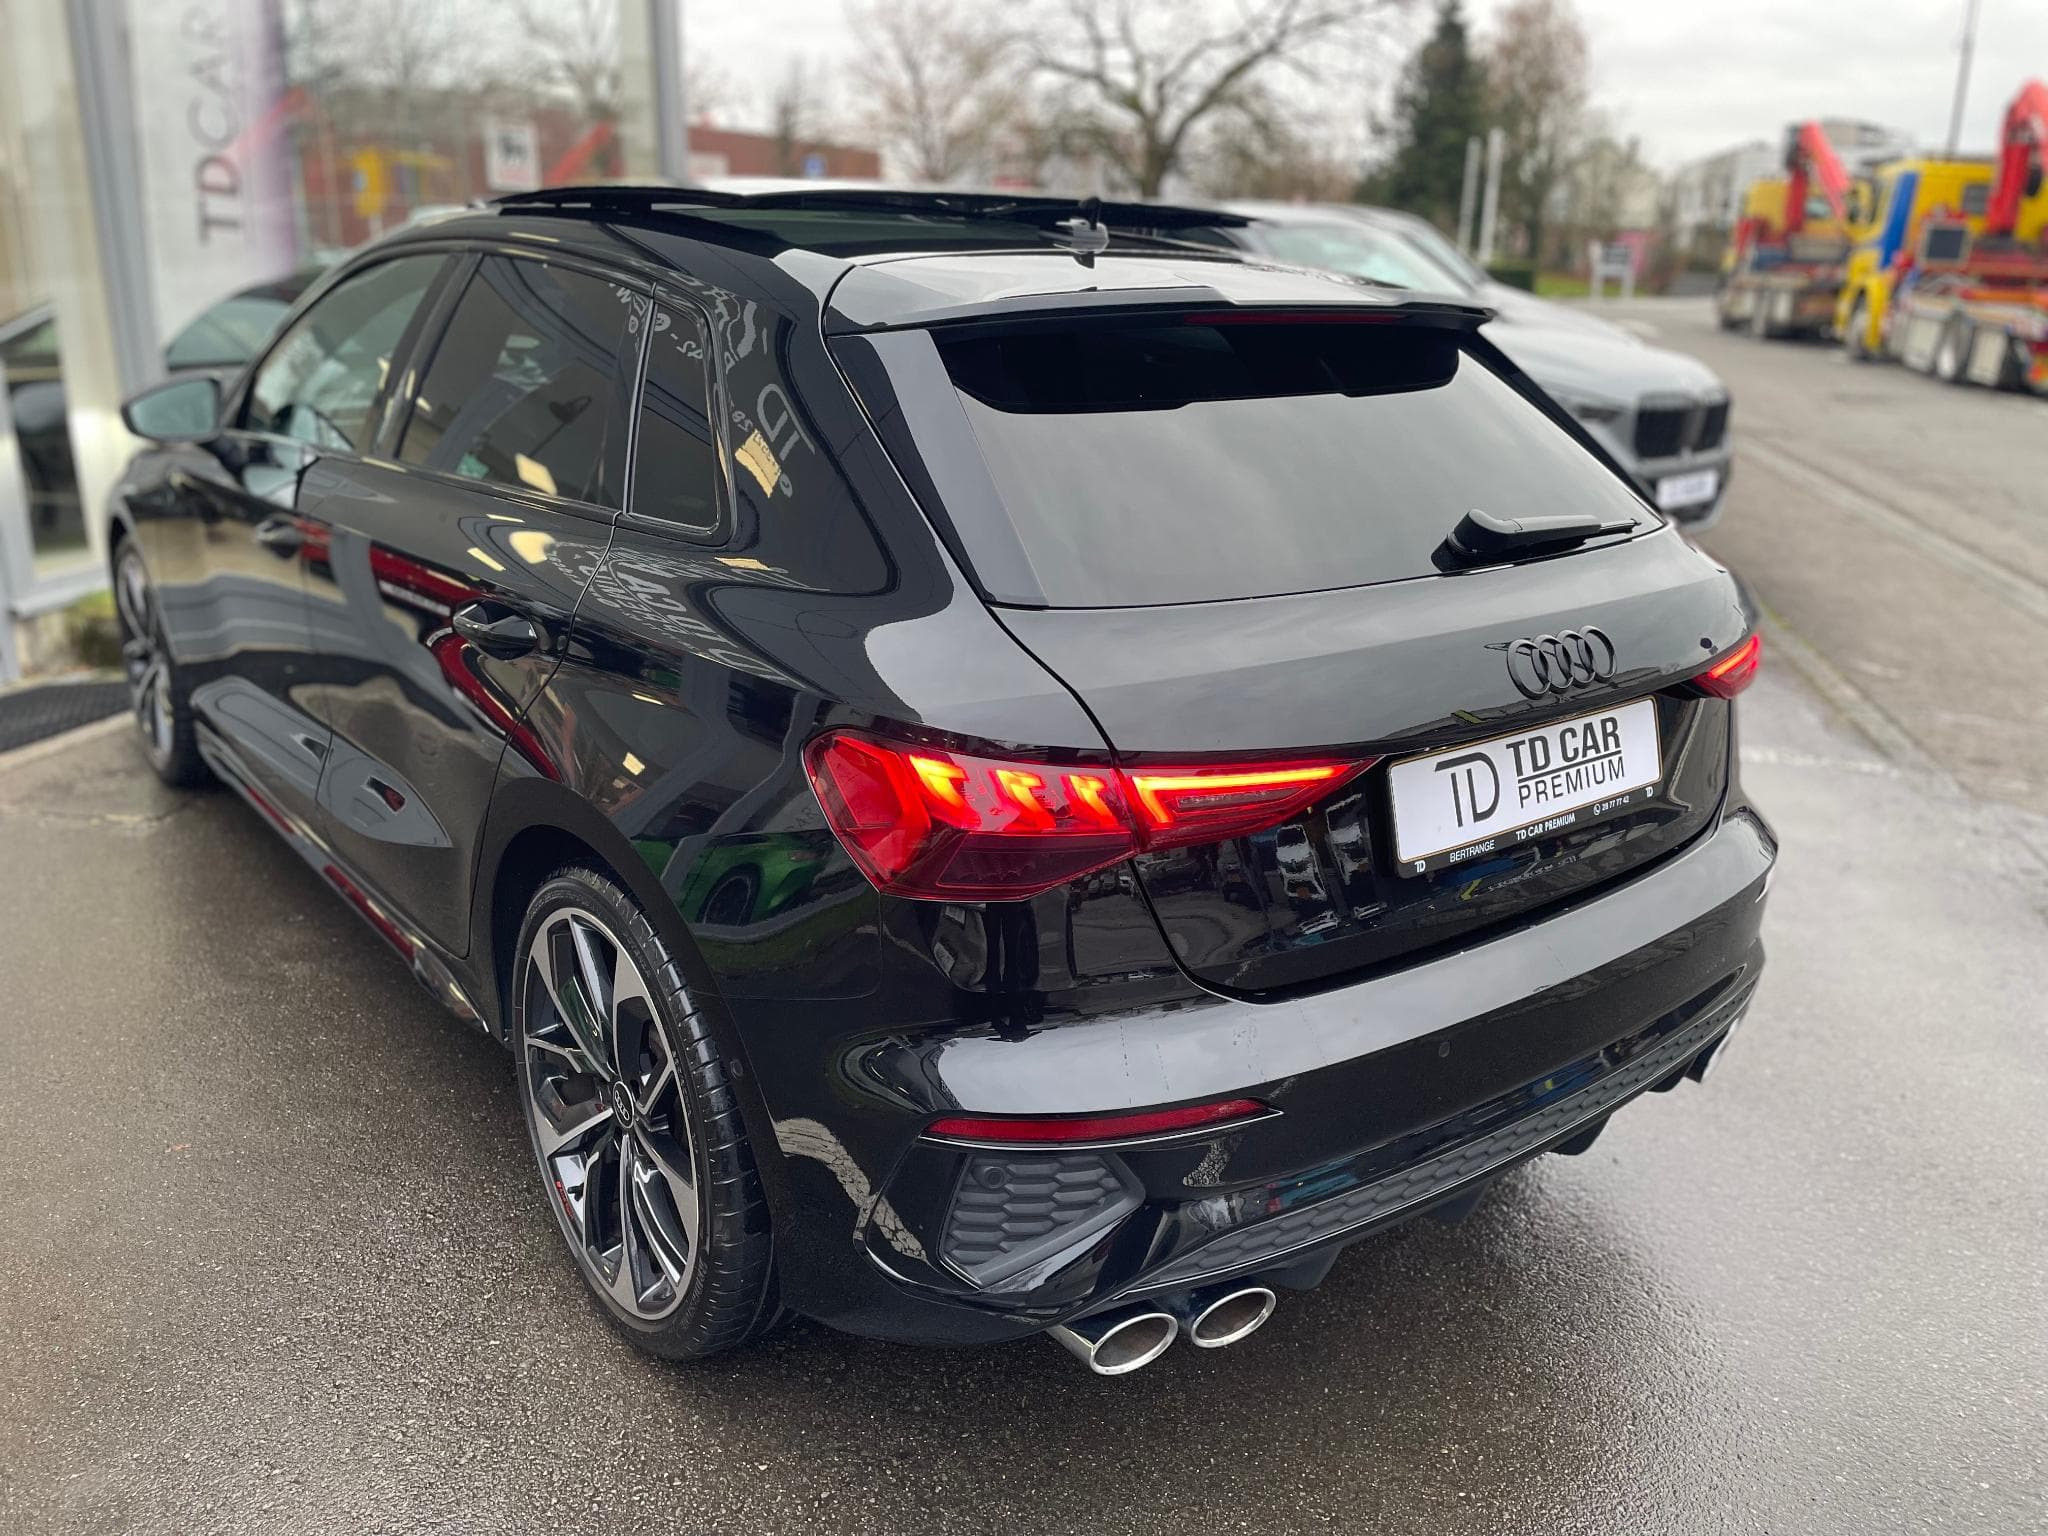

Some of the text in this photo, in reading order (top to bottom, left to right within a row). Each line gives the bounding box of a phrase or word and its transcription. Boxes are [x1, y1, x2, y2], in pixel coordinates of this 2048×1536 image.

[1506, 716, 1622, 777] TD CAR
[1519, 756, 1626, 809] PREMIUM
[1515, 812, 1576, 840] TD CAR PREMIUM
[1449, 840, 1496, 863] BERTRANGE
